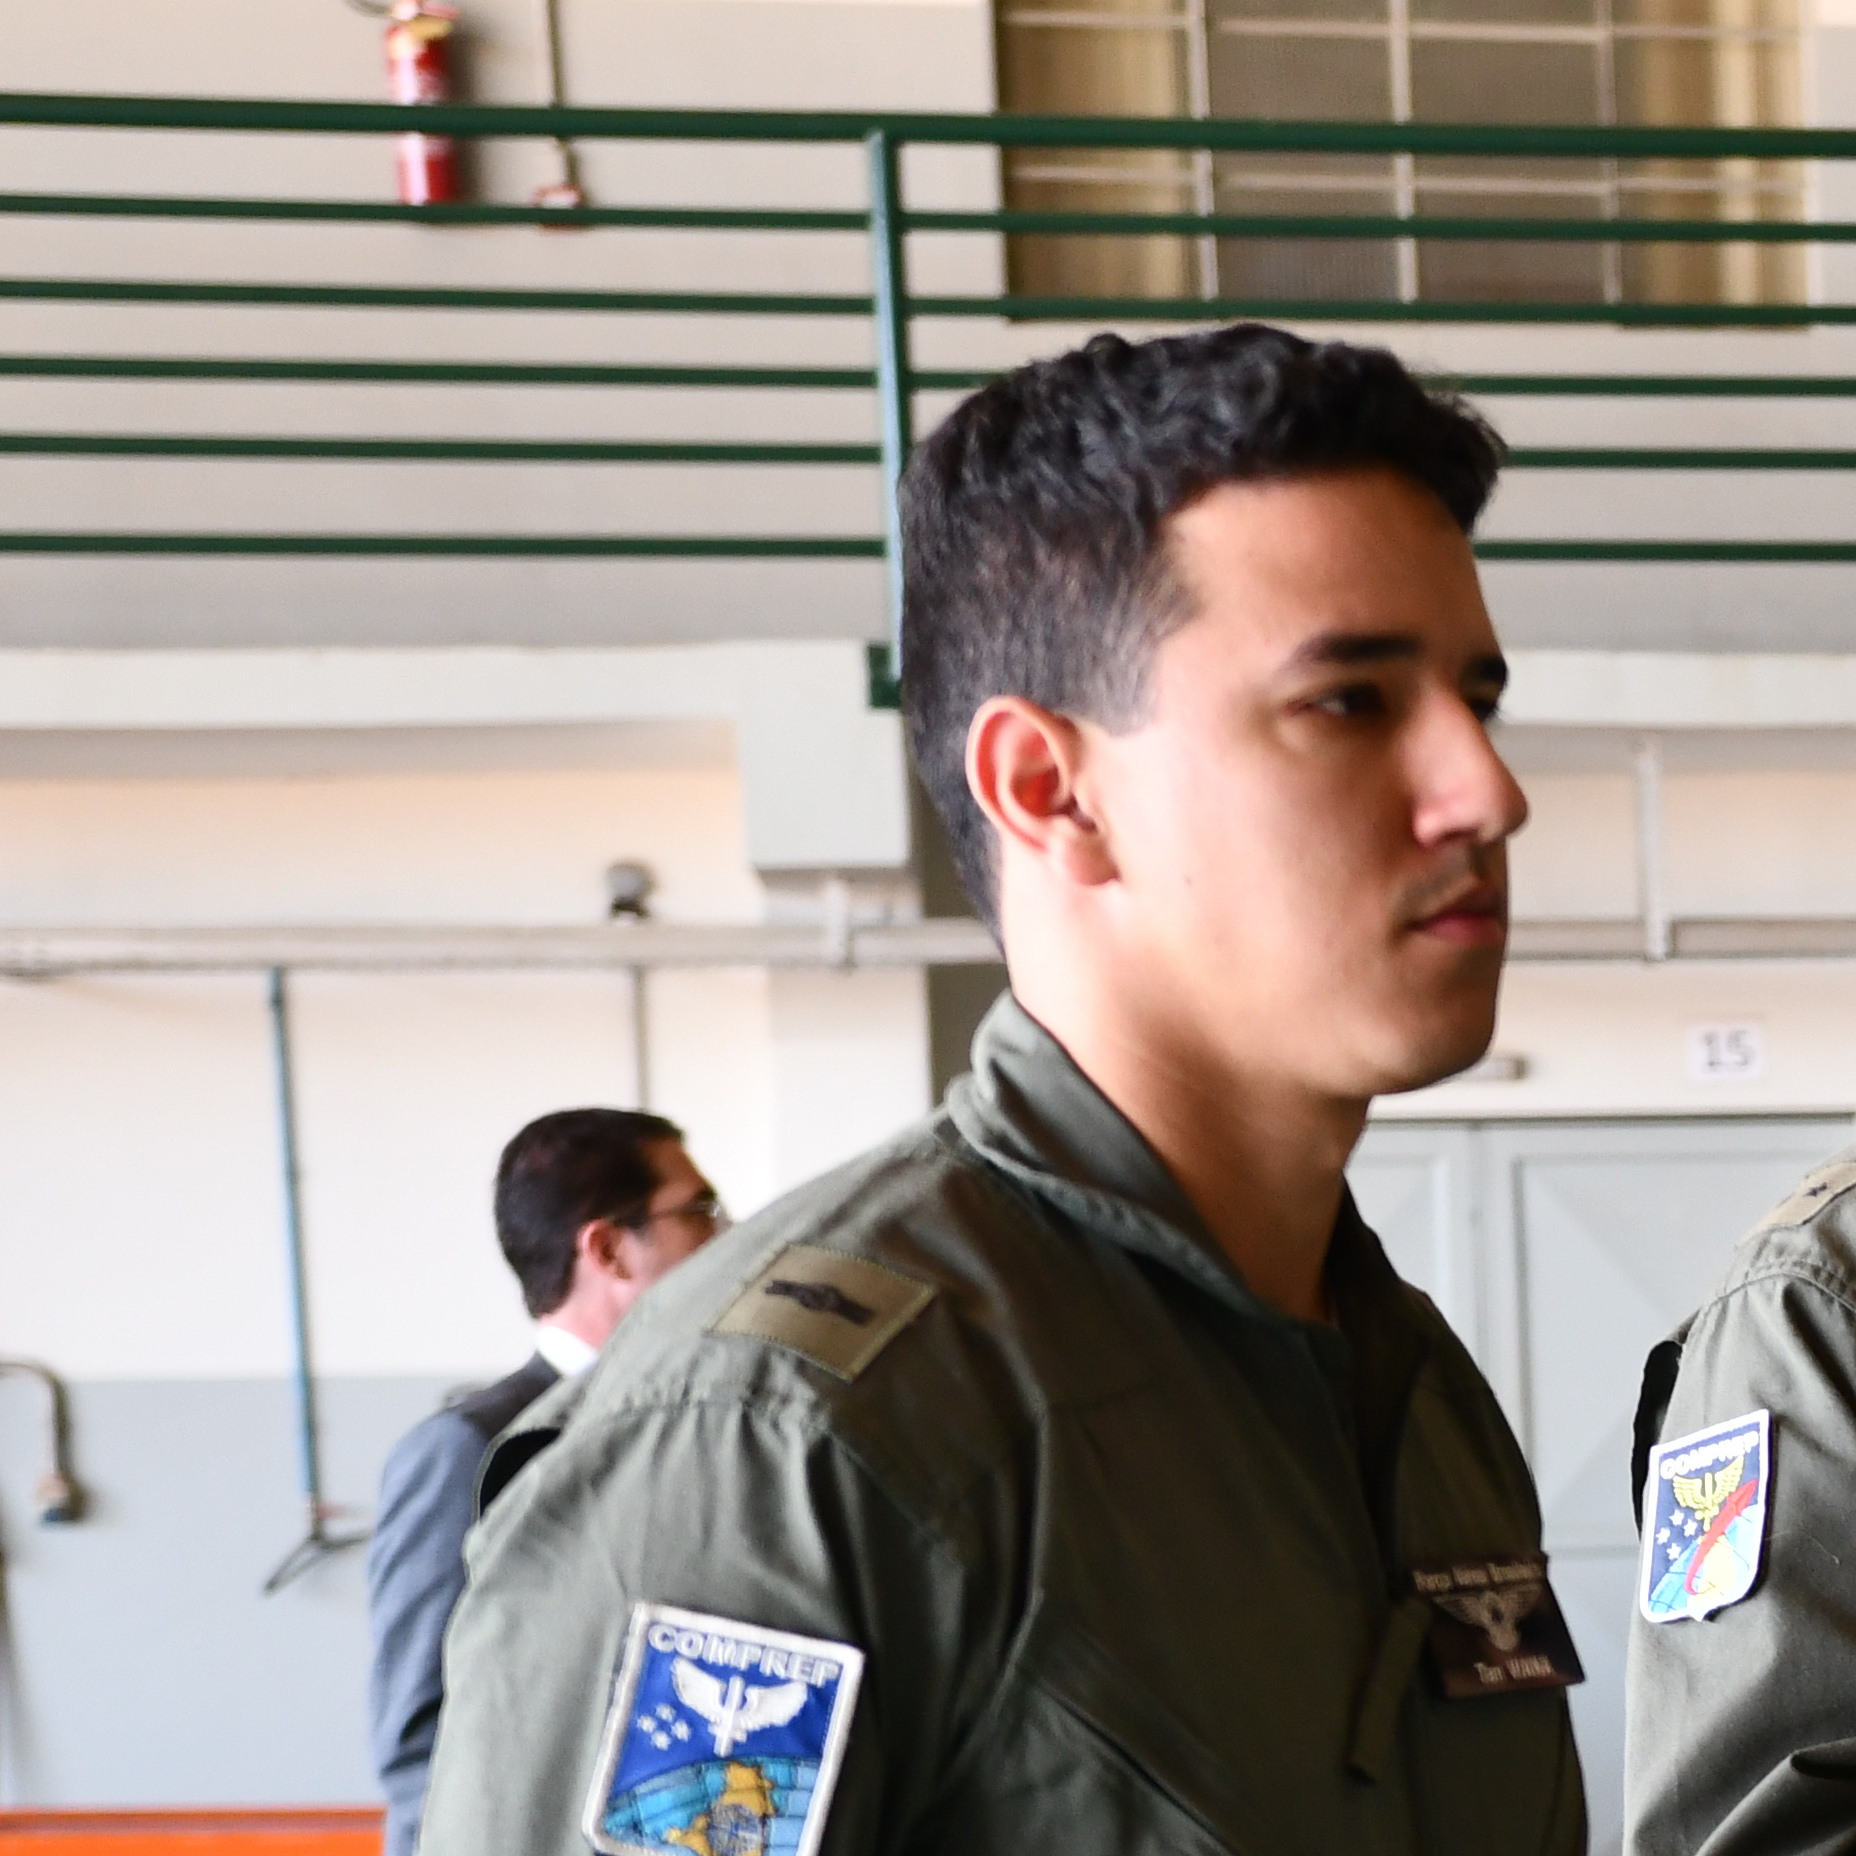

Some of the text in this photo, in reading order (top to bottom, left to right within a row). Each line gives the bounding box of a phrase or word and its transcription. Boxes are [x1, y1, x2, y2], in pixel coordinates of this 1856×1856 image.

[1701, 1029, 1756, 1073] 15
[1659, 1431, 1760, 1480] COMPREP
[646, 1622, 840, 1689] COMPREP
